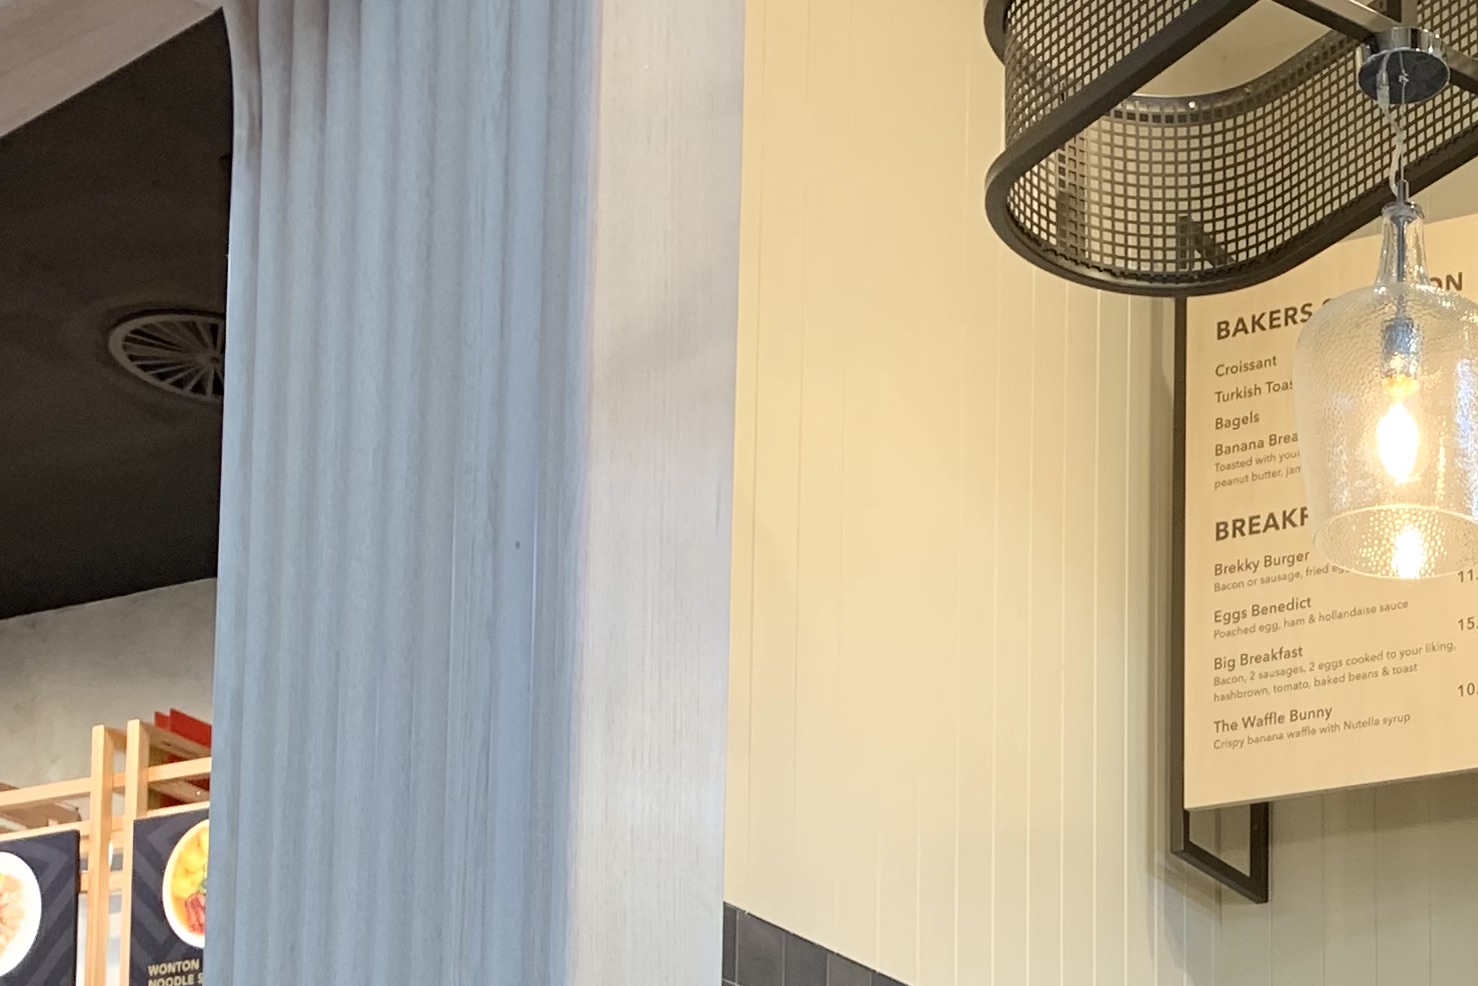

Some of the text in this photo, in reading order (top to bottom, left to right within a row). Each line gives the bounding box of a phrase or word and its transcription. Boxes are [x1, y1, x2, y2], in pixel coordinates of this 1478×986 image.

[1216, 303, 1313, 340] BAKERS
[1214, 355, 1277, 377] Croissant
[1214, 383, 1262, 403] Turkish
[1214, 411, 1260, 430] Bagels
[1214, 432, 1298, 456] Banana Brea
[1215, 506, 1309, 541] BREAKF
[1214, 551, 1310, 576] Brekky Burger
[1214, 597, 1311, 625] Eggs Benedict
[1307, 613, 1316, 624] &
[1214, 646, 1303, 672] Big Breakfast
[1213, 707, 1332, 733] The Waffle Bunny
[148, 959, 200, 976] WONTON
